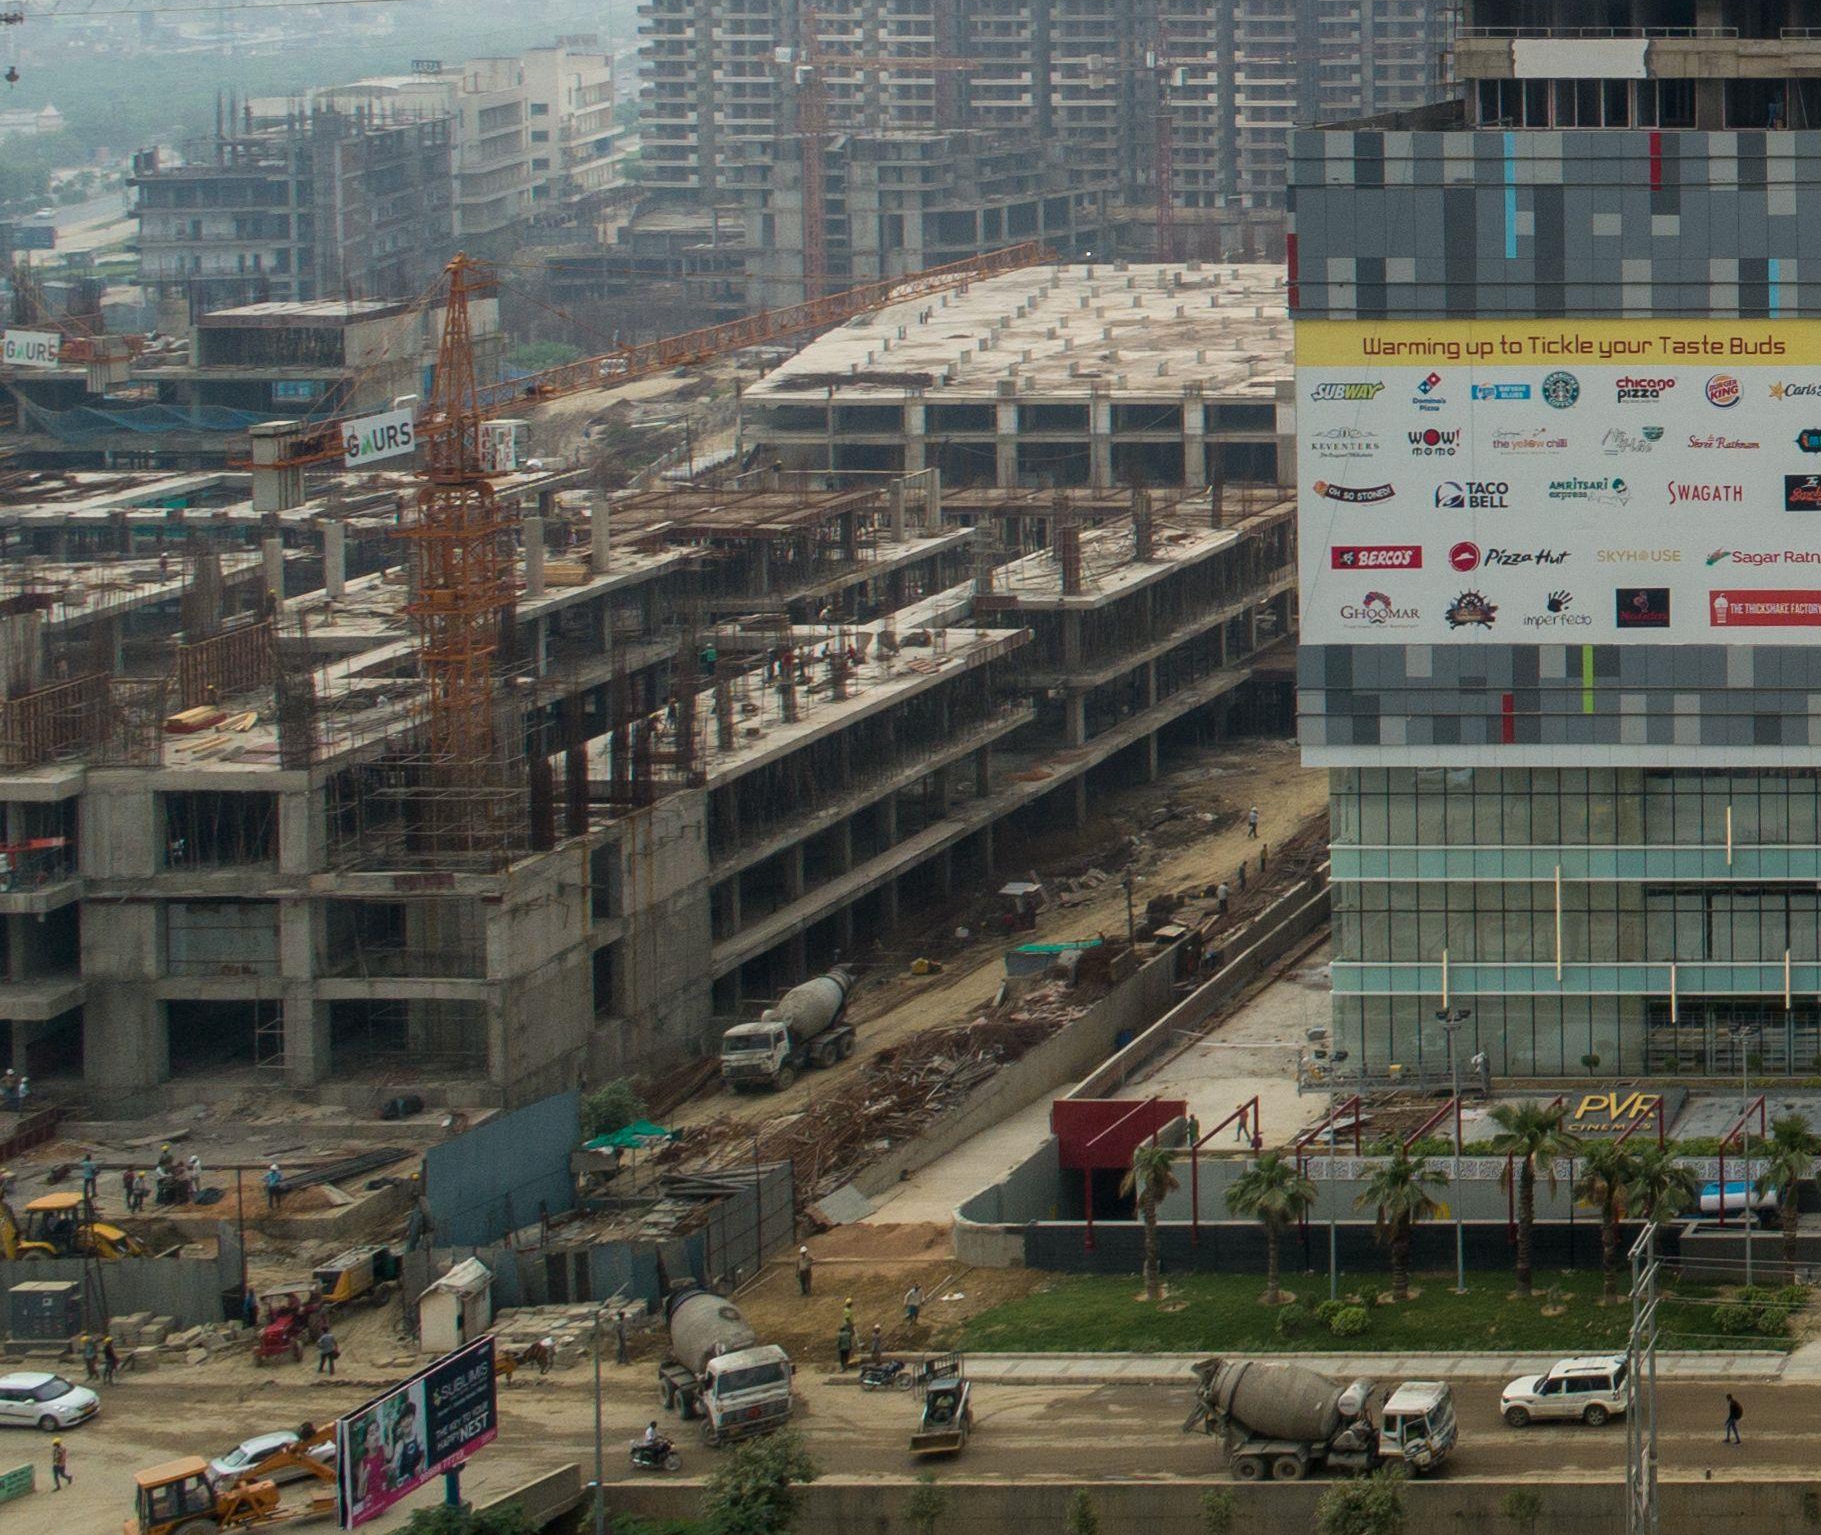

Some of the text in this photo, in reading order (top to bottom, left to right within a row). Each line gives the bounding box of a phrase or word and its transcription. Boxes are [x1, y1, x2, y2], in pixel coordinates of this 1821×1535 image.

[6, 340, 57, 362] GAURS
[1363, 334, 1786, 360] Warming up to Tickle your Taste Buds
[1311, 380, 1385, 402] SUBWAY
[1616, 376, 1675, 391] chicago
[1708, 379, 1738, 392] BURGER
[1617, 388, 1660, 403] pizza
[1710, 386, 1739, 401] KING
[346, 422, 412, 458] GAURS
[1311, 441, 1380, 450] KEVENTERS
[1493, 438, 1569, 452] the yellow chilli
[1412, 447, 1456, 456] momo
[1465, 481, 1509, 494] TACO
[1549, 490, 1588, 500] express
[1667, 480, 1743, 505] SWAGATH
[1469, 496, 1509, 508] BELL
[1358, 549, 1413, 565] BERCO'S
[1485, 548, 1571, 567] Pizza Hut
[1732, 551, 1781, 566] Sagar
[1340, 605, 1420, 622] GHOOMAR
[1730, 603, 1743, 614] THE
[1745, 603, 1789, 614] THICKSHAKE
[1574, 1091, 1662, 1121] PVR
[1567, 1123, 1652, 1132] CINEMS
[460, 1412, 489, 1443] NEST
